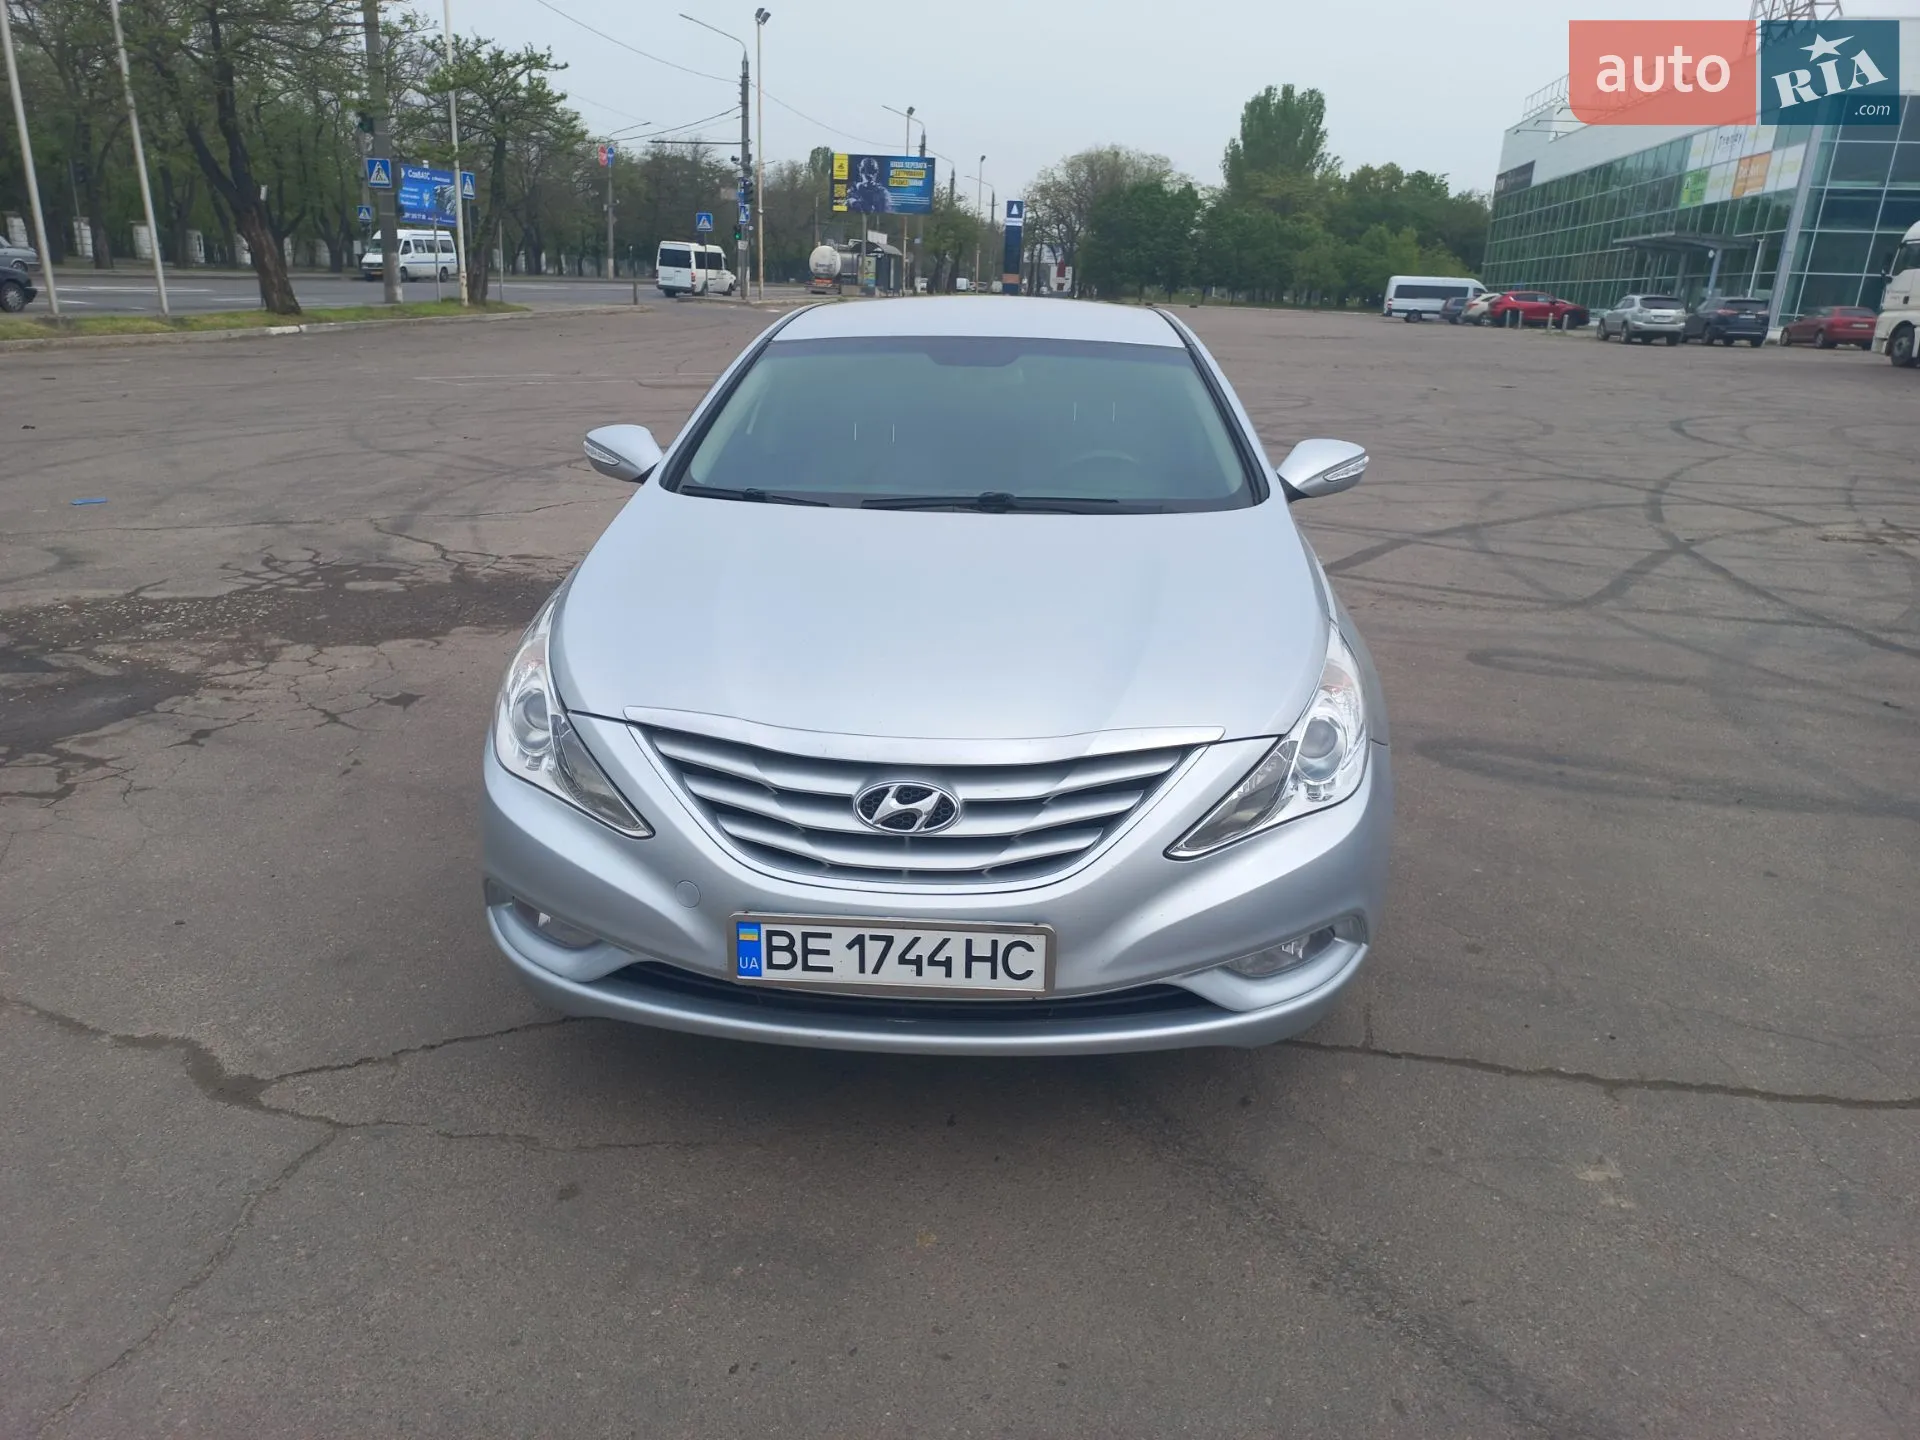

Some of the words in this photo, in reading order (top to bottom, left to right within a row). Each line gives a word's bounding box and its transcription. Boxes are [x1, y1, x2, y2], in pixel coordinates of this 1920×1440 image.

[739, 955, 759, 970] UA
[765, 929, 834, 973] BE
[845, 933, 953, 979] 1744
[964, 938, 1035, 981] HC
